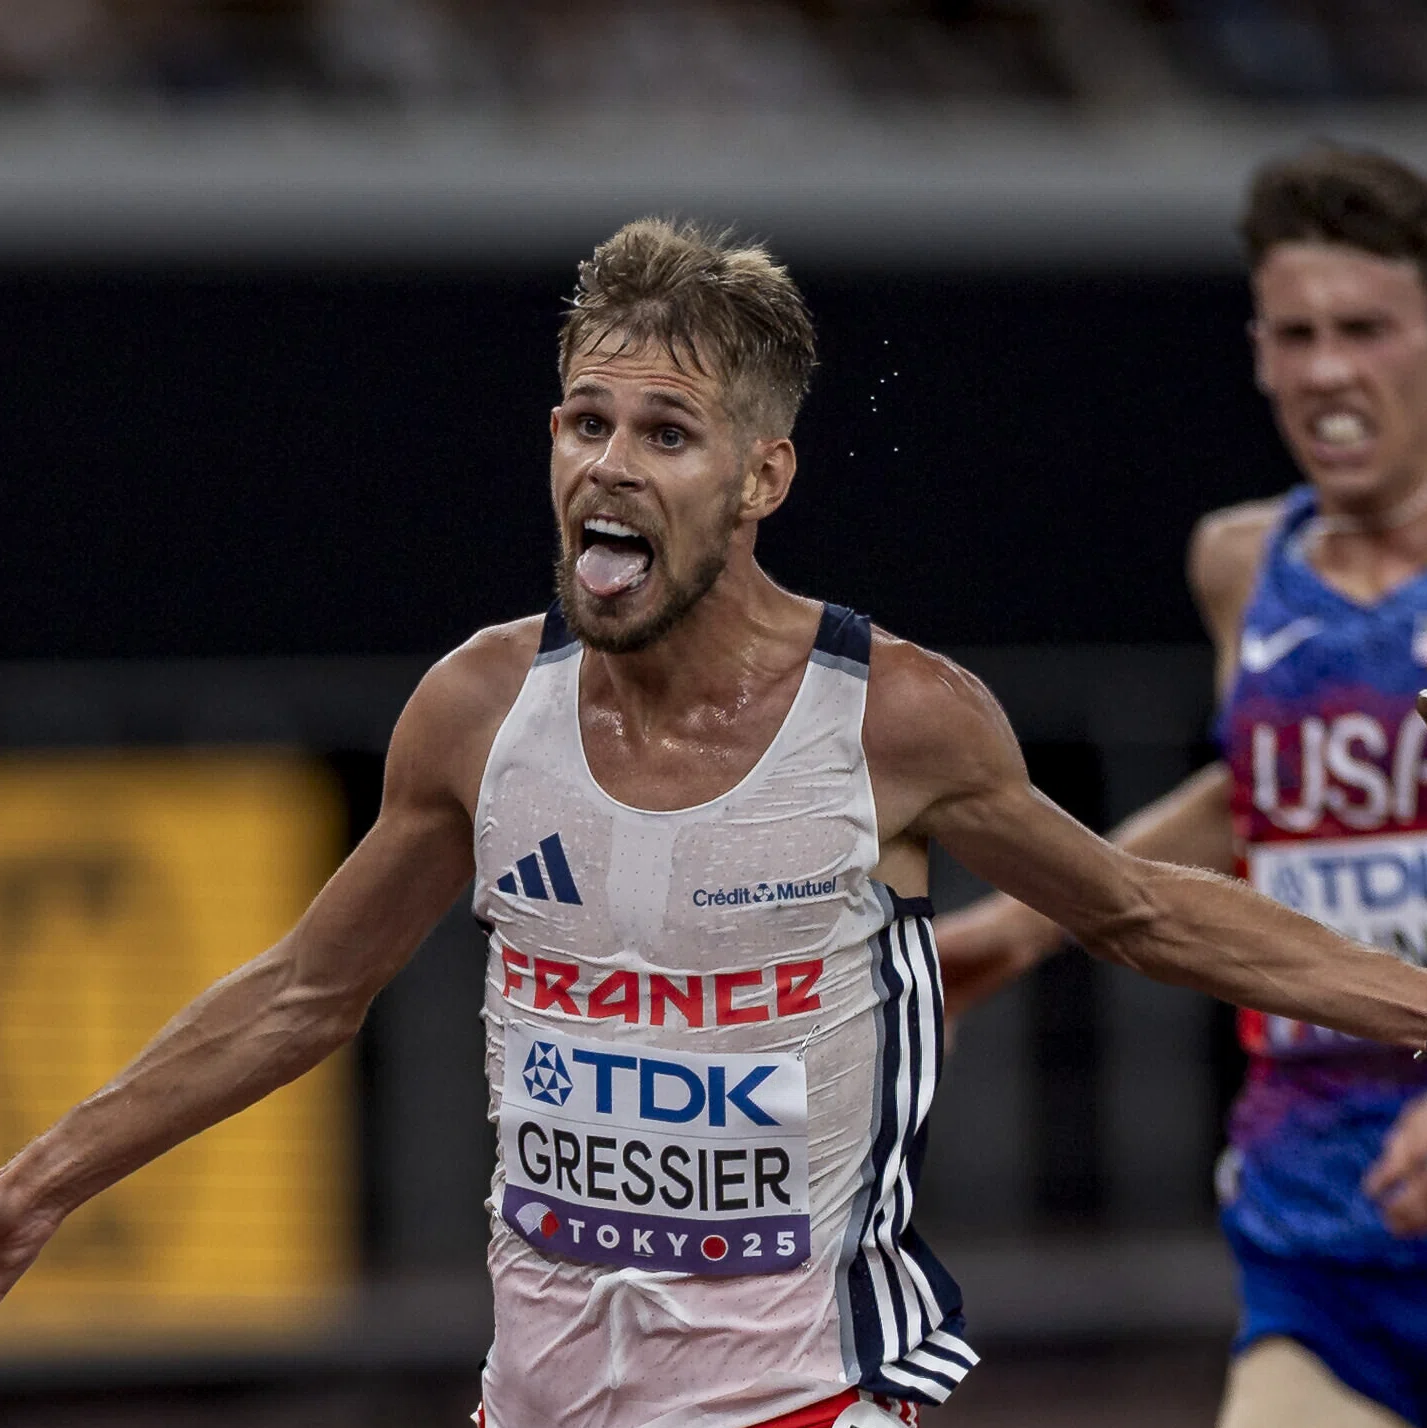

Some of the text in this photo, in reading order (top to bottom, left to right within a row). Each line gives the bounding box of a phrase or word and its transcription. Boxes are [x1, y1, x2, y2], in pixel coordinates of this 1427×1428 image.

[693, 877, 837, 906] Crédit Mutuel
[502, 944, 824, 1028] FRANCE
[573, 1049, 782, 1127] TDK
[518, 1122, 790, 1212] GRESSIER
[743, 1231, 796, 1258] 25
